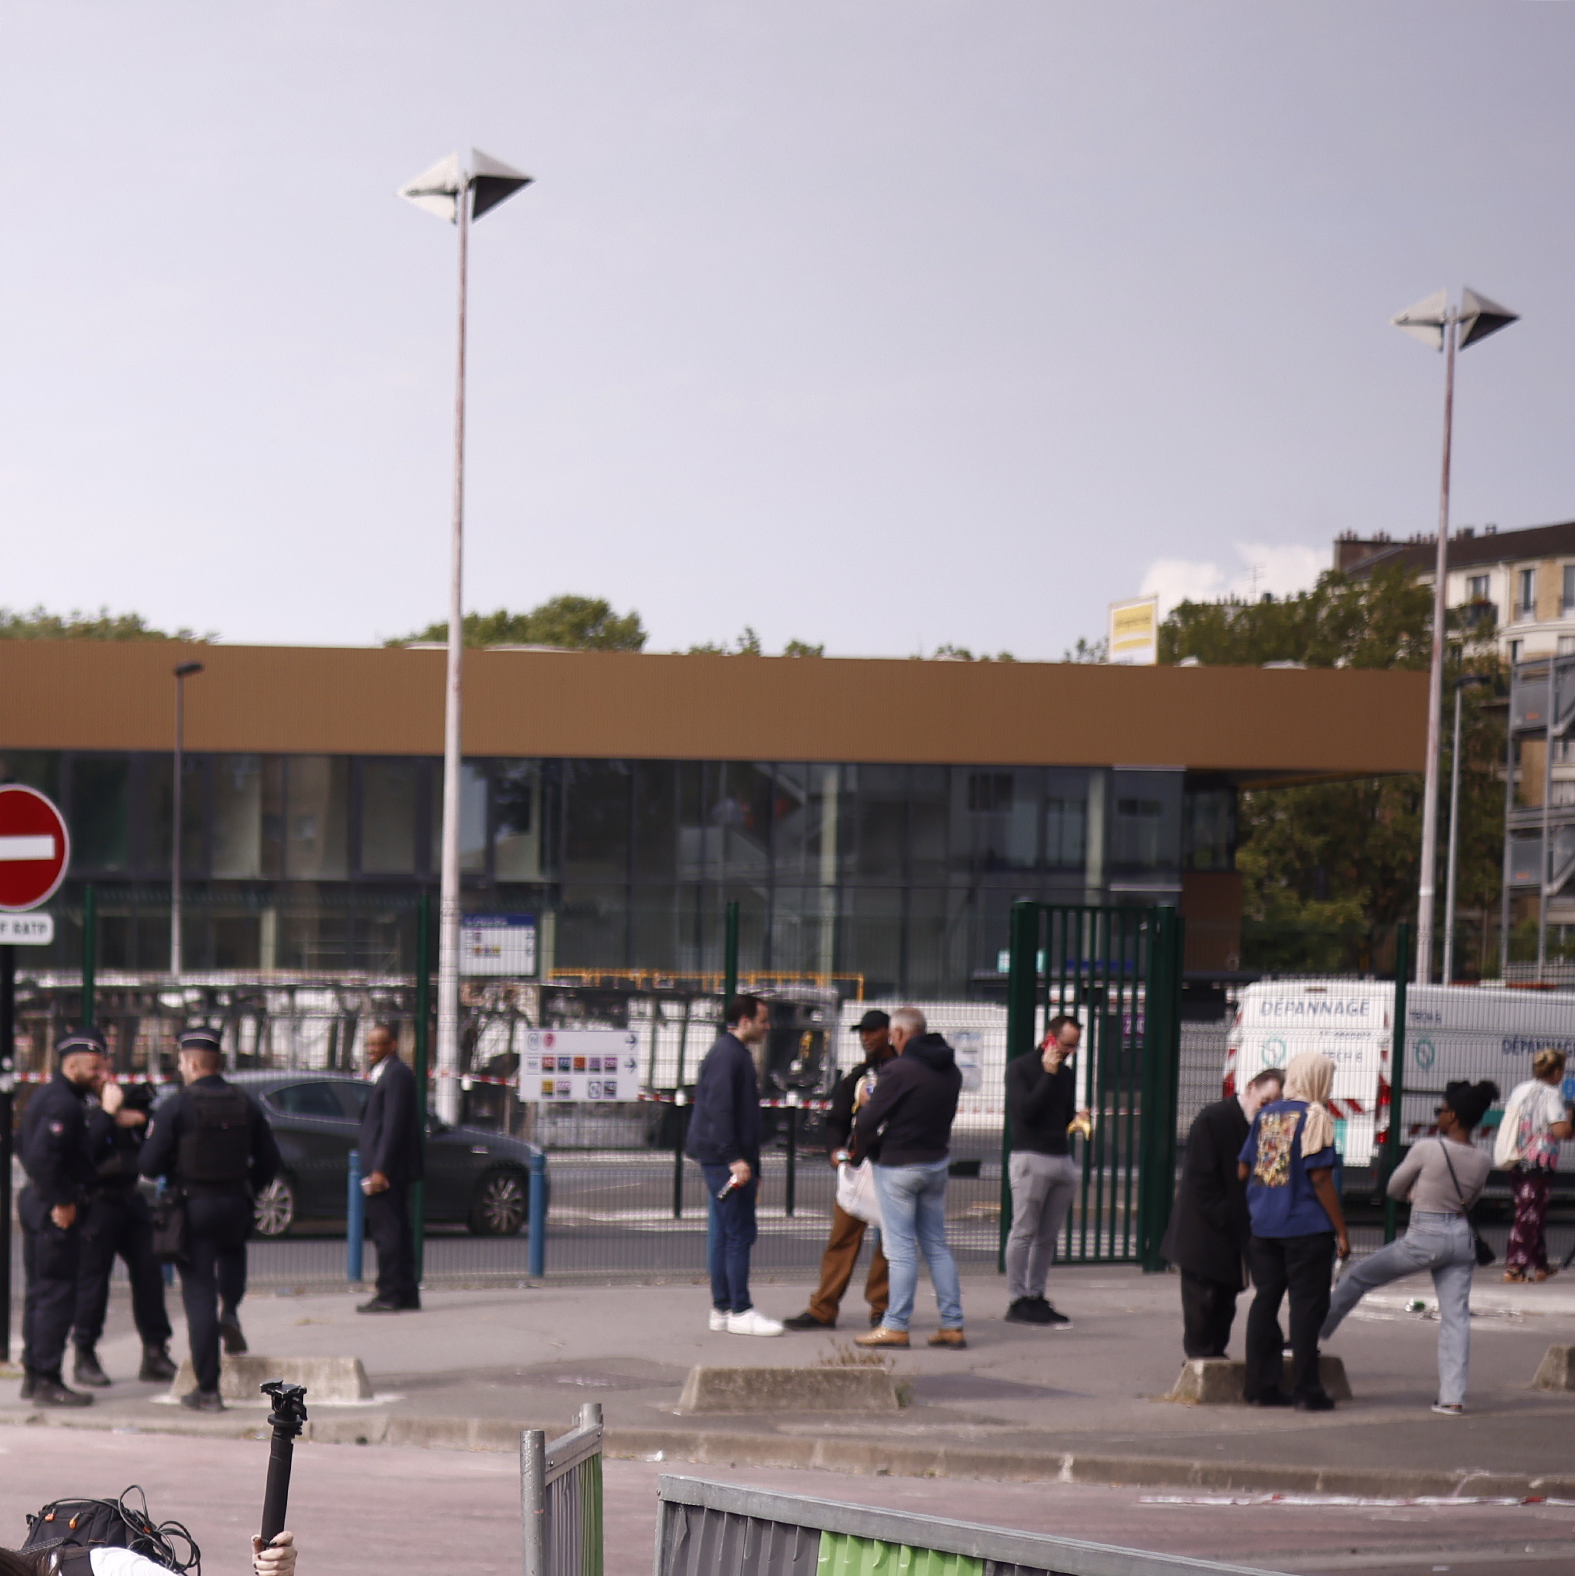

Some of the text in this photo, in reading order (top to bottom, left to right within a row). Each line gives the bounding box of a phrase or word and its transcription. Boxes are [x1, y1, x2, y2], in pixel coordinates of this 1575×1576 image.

[12, 920, 48, 935] RATP
[1261, 997, 1370, 1017] DÉPANNAGE
[1502, 1034, 1575, 1057] DÉPANG
